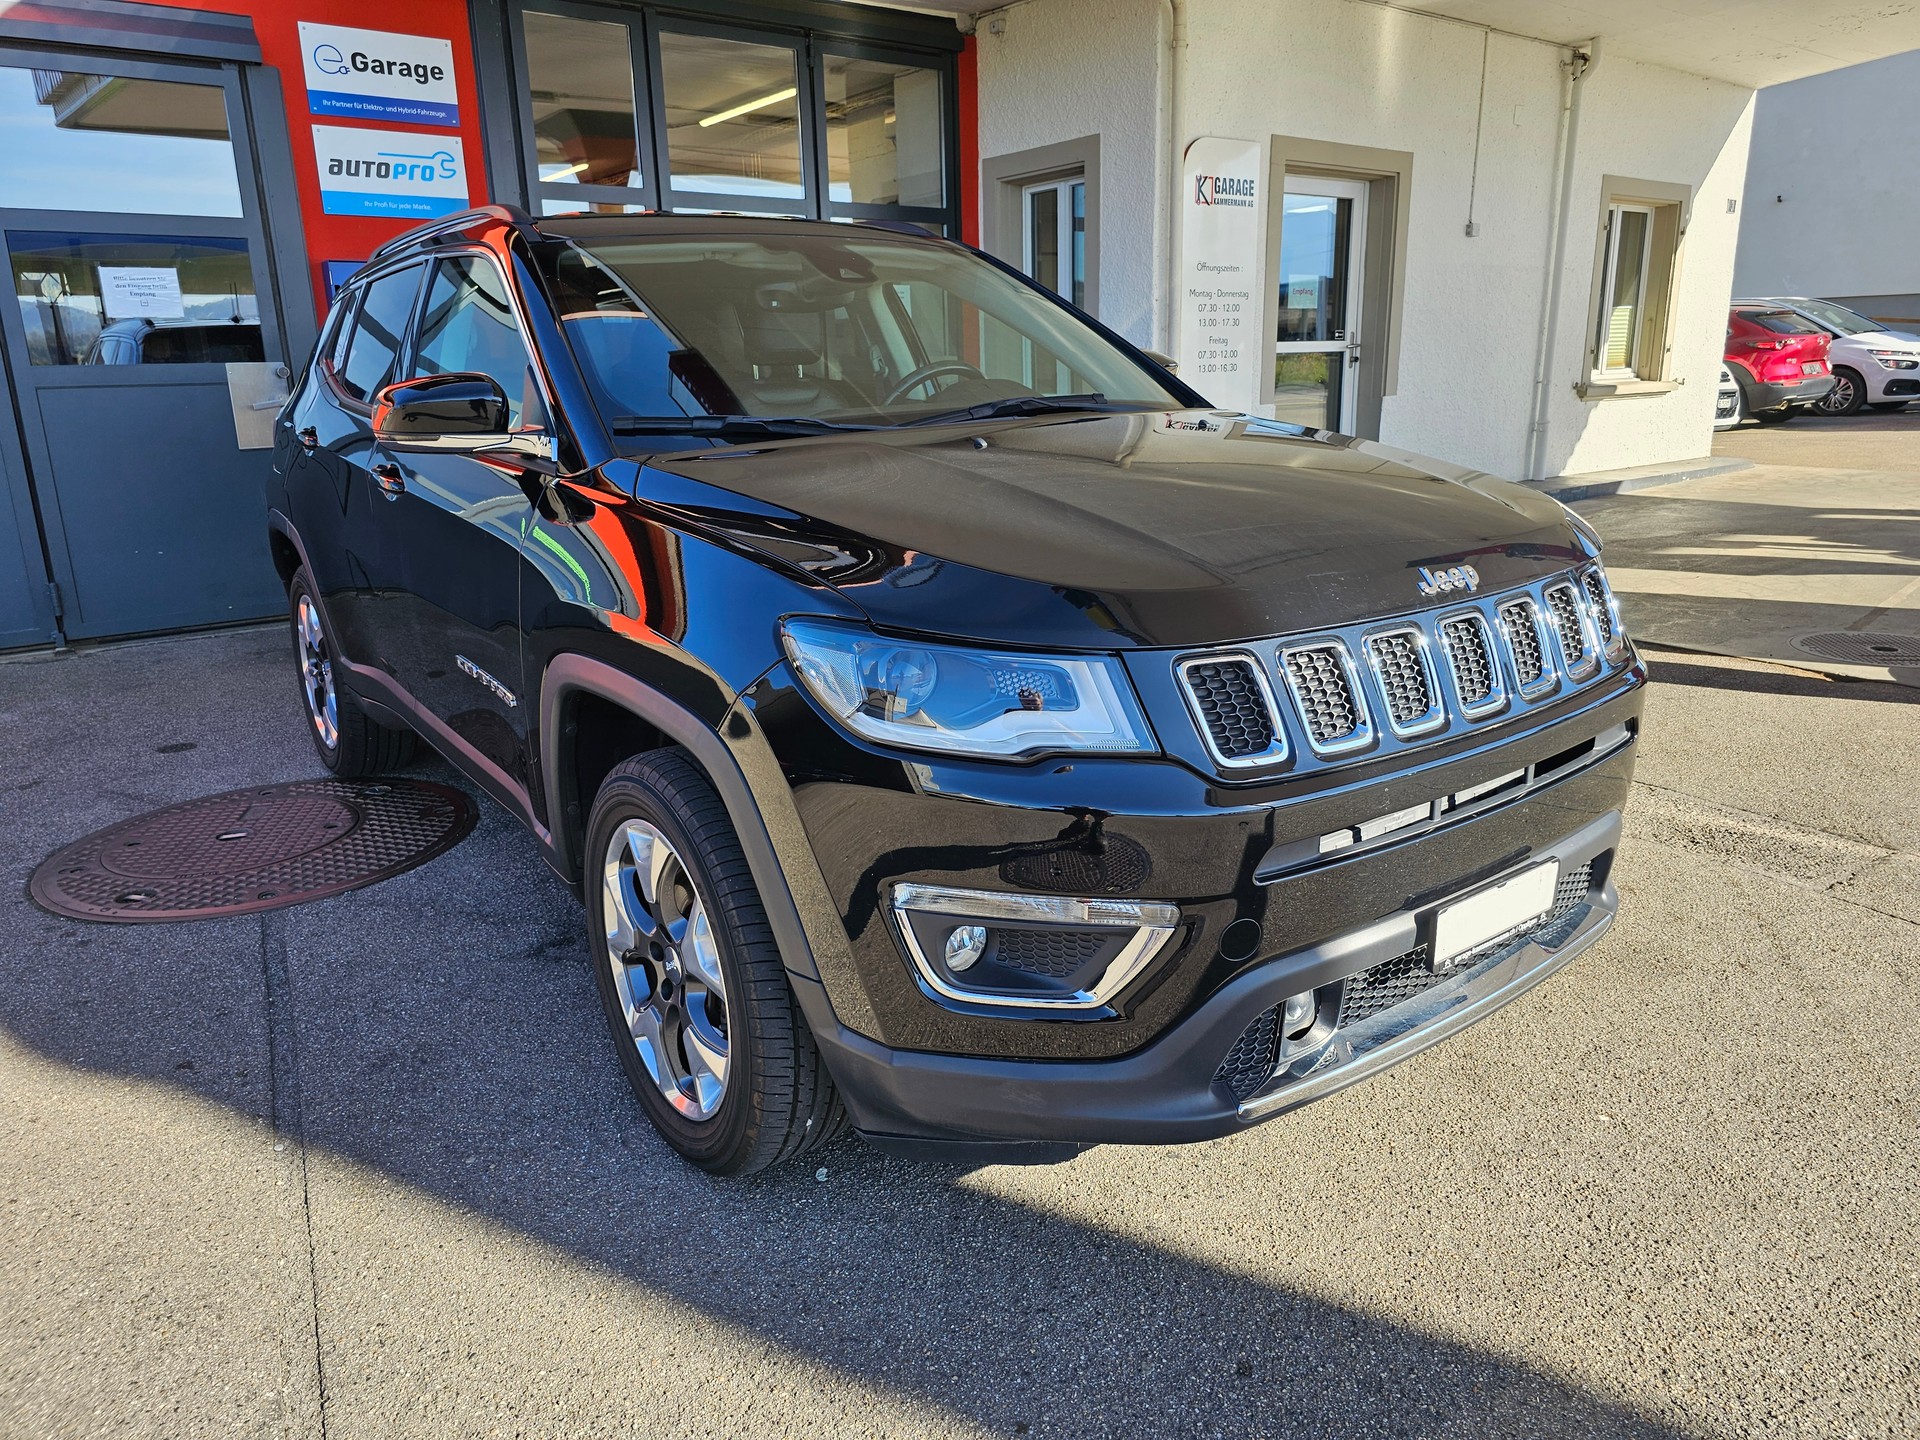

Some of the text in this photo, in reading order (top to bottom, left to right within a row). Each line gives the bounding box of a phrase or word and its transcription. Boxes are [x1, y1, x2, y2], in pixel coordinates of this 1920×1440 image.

[332, 100, 353, 109] Partner
[363, 103, 385, 111] Elektro-
[1214, 176, 1255, 197] GARAGE
[398, 202, 412, 210] jede
[1214, 198, 1254, 208] KAMMERMANN AG
[1189, 288, 1213, 301] Montag
[1216, 288, 1249, 301] Donnerstag
[1292, 288, 1314, 296] Empfang
[1197, 303, 1218, 313] 07.30
[1222, 303, 1241, 313] 12.00
[1198, 318, 1217, 327] 13.00
[1222, 318, 1240, 327] 17.30
[1208, 335, 1229, 347] Freitag
[1416, 564, 1480, 597] Jeep
